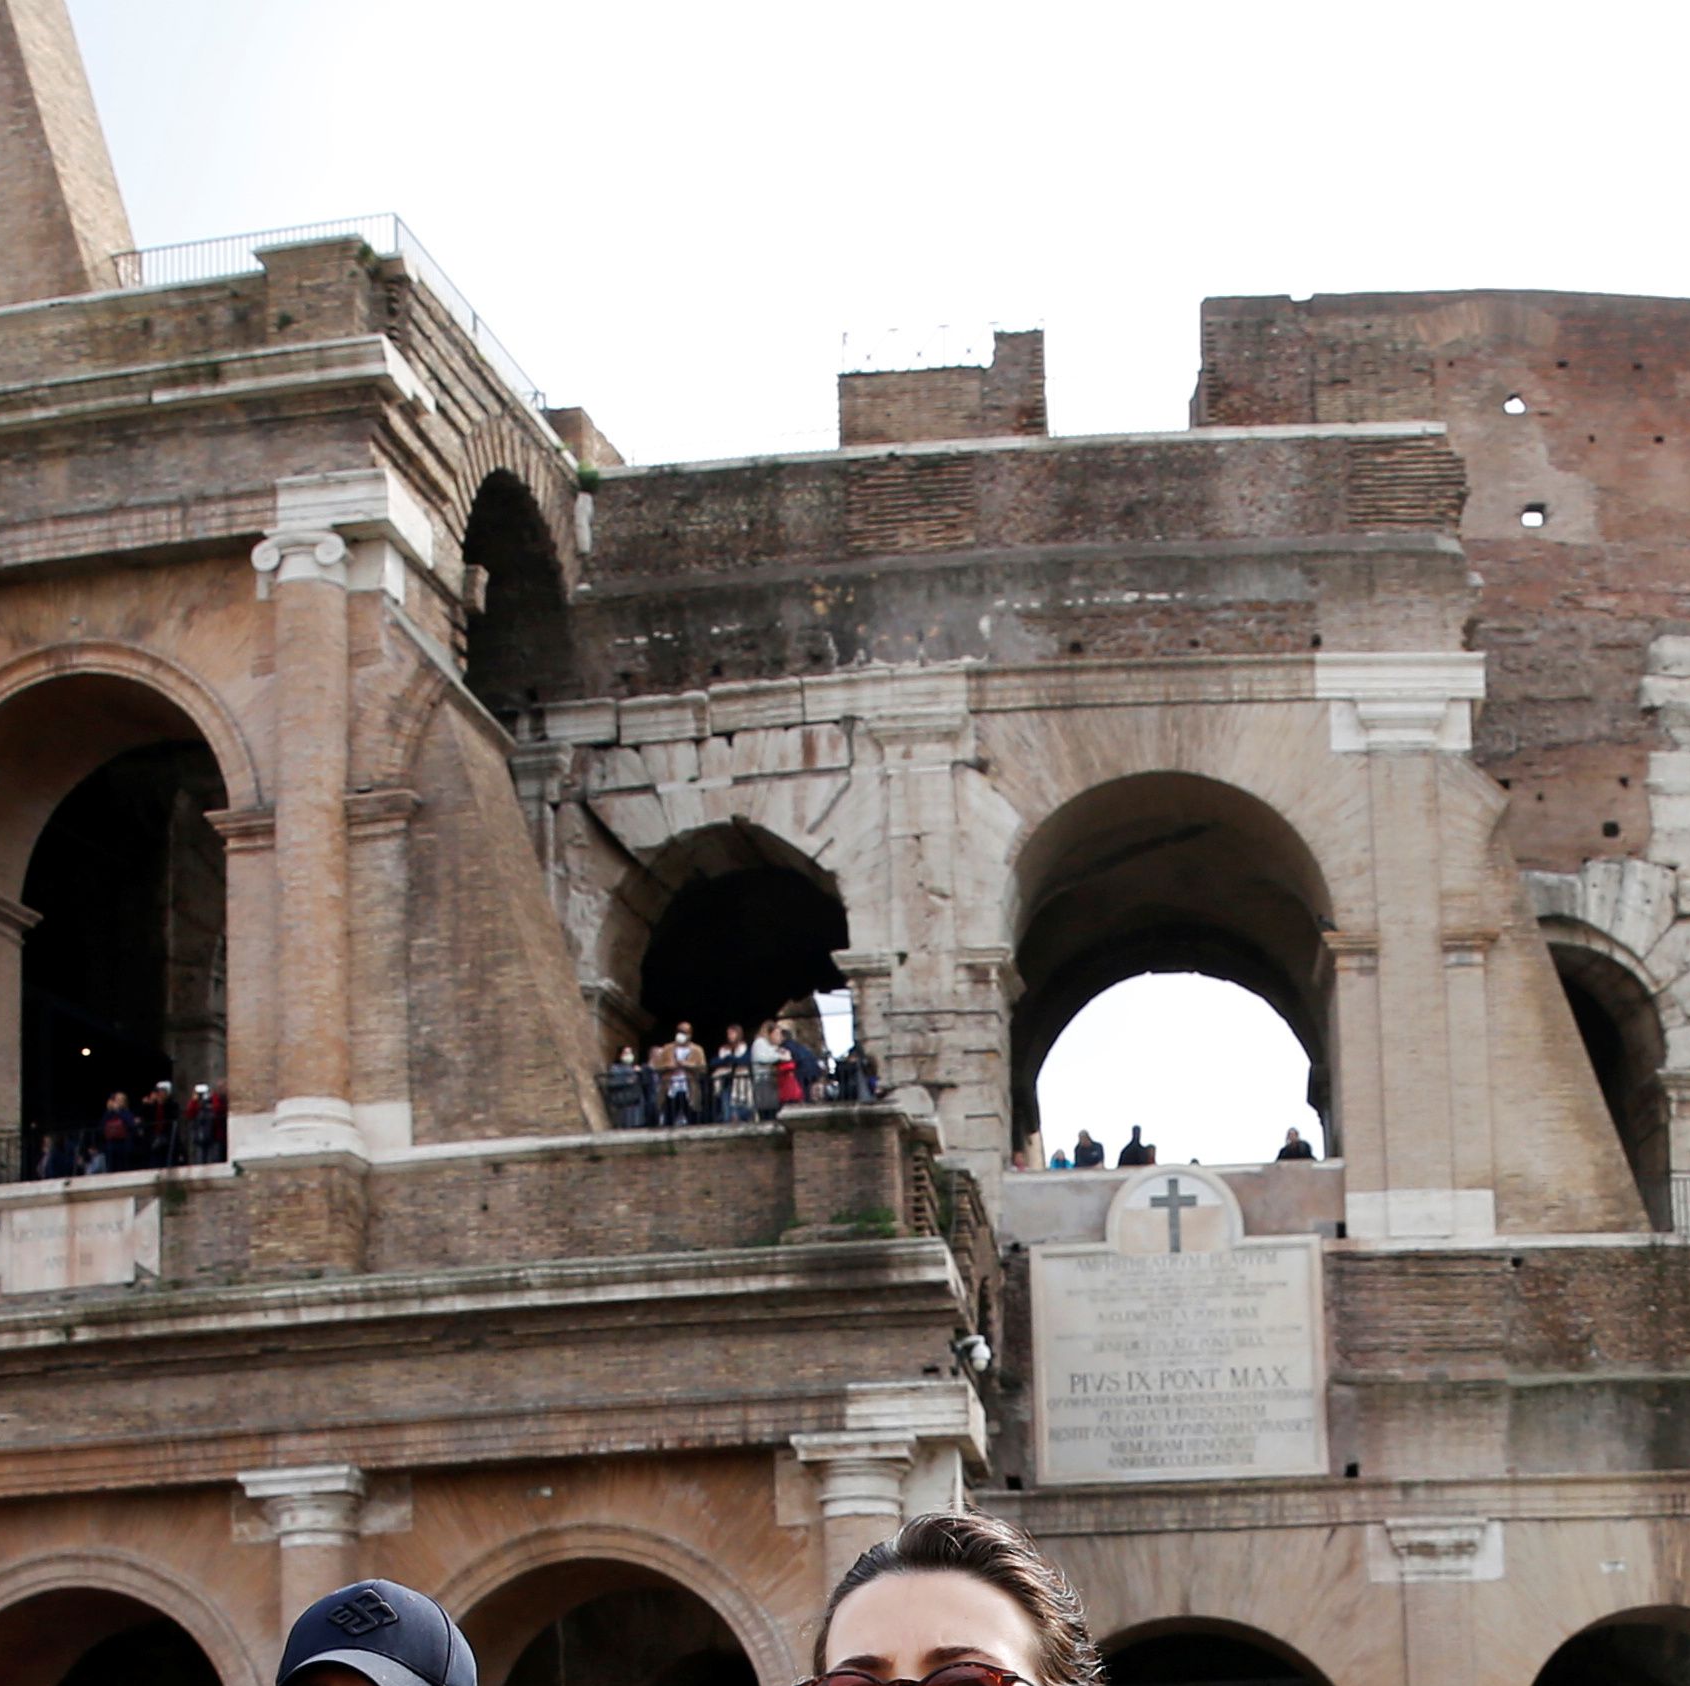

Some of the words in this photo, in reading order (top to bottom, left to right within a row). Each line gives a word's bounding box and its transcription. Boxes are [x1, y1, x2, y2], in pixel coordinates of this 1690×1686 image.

[1069, 1371, 1121, 1395] PIVS
[1126, 1370, 1152, 1393] IX
[1159, 1366, 1222, 1391] PONT
[1229, 1364, 1289, 1388] MAX
